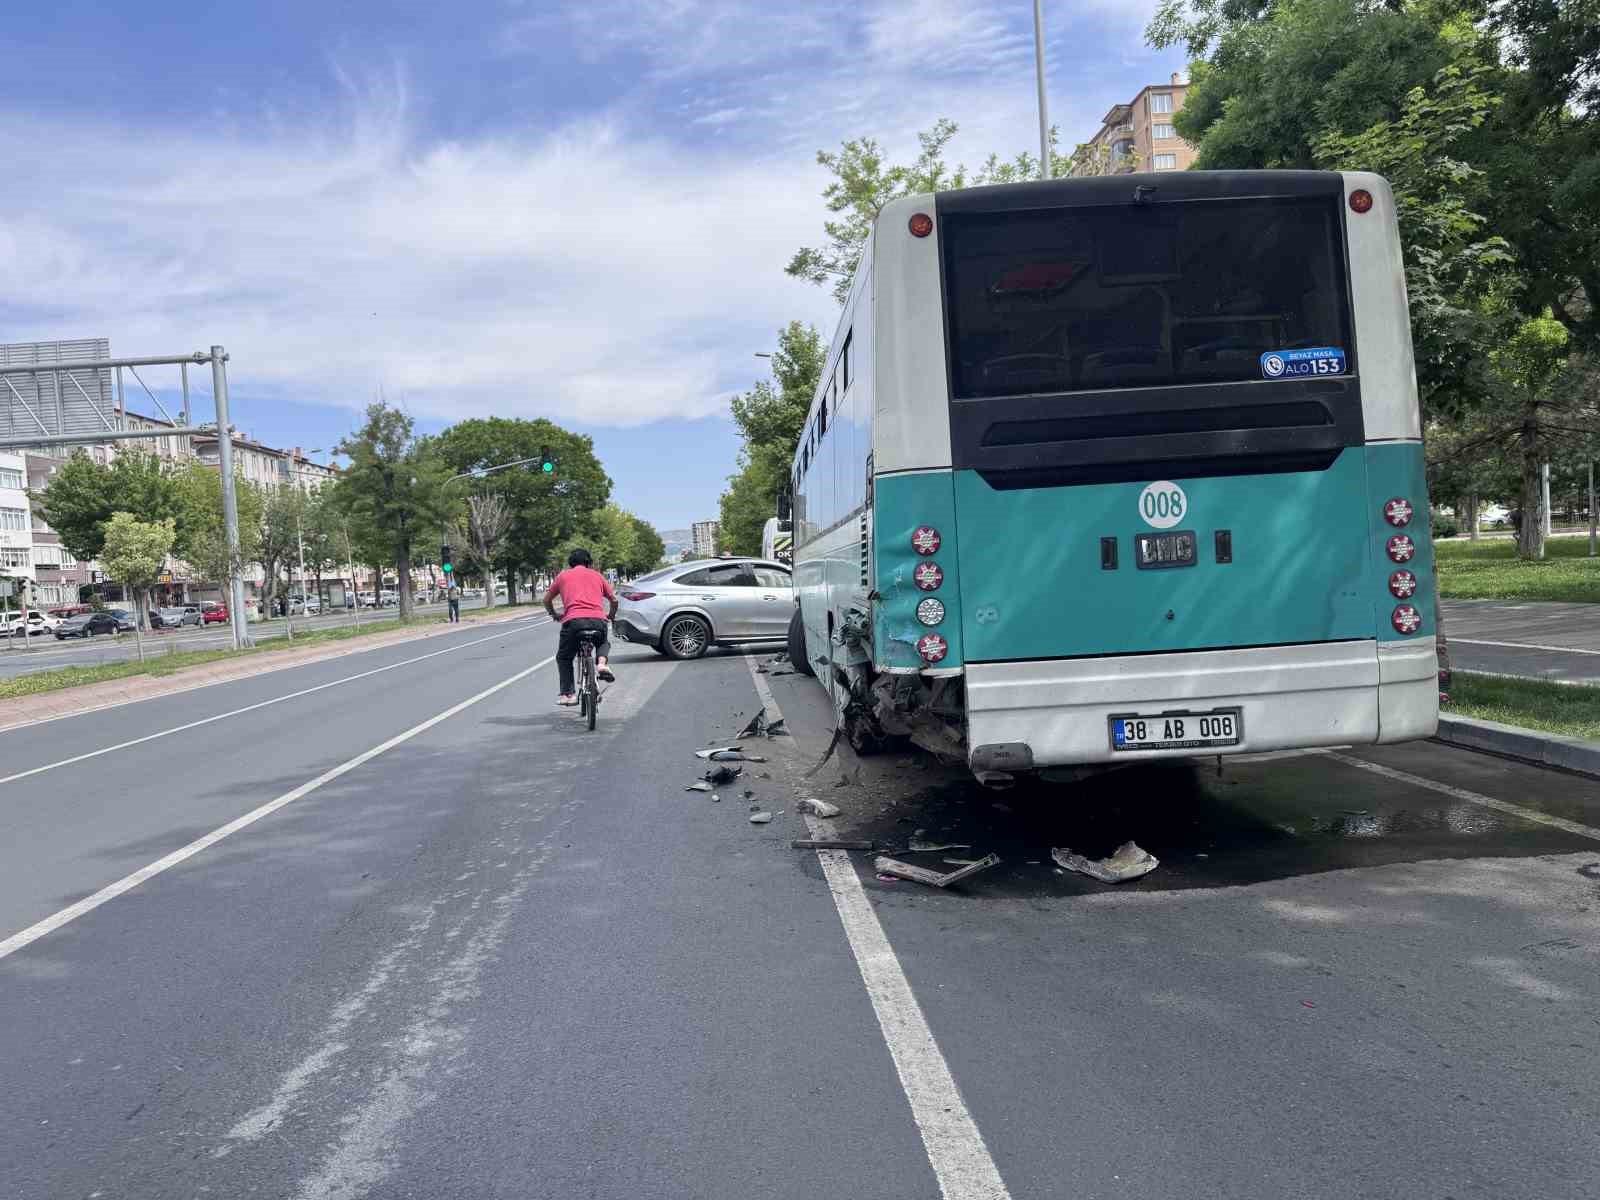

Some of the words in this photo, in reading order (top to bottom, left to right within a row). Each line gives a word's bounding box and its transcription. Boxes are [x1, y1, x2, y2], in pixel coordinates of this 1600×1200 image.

[1288, 352, 1311, 360] BEYAZ
[1313, 350, 1333, 359] MASA
[1285, 363, 1309, 374] ALO
[1311, 358, 1339, 373] 153
[1144, 490, 1182, 518] 008
[1124, 721, 1147, 740] 38
[1163, 719, 1185, 739] AB
[1200, 717, 1233, 737] 008
